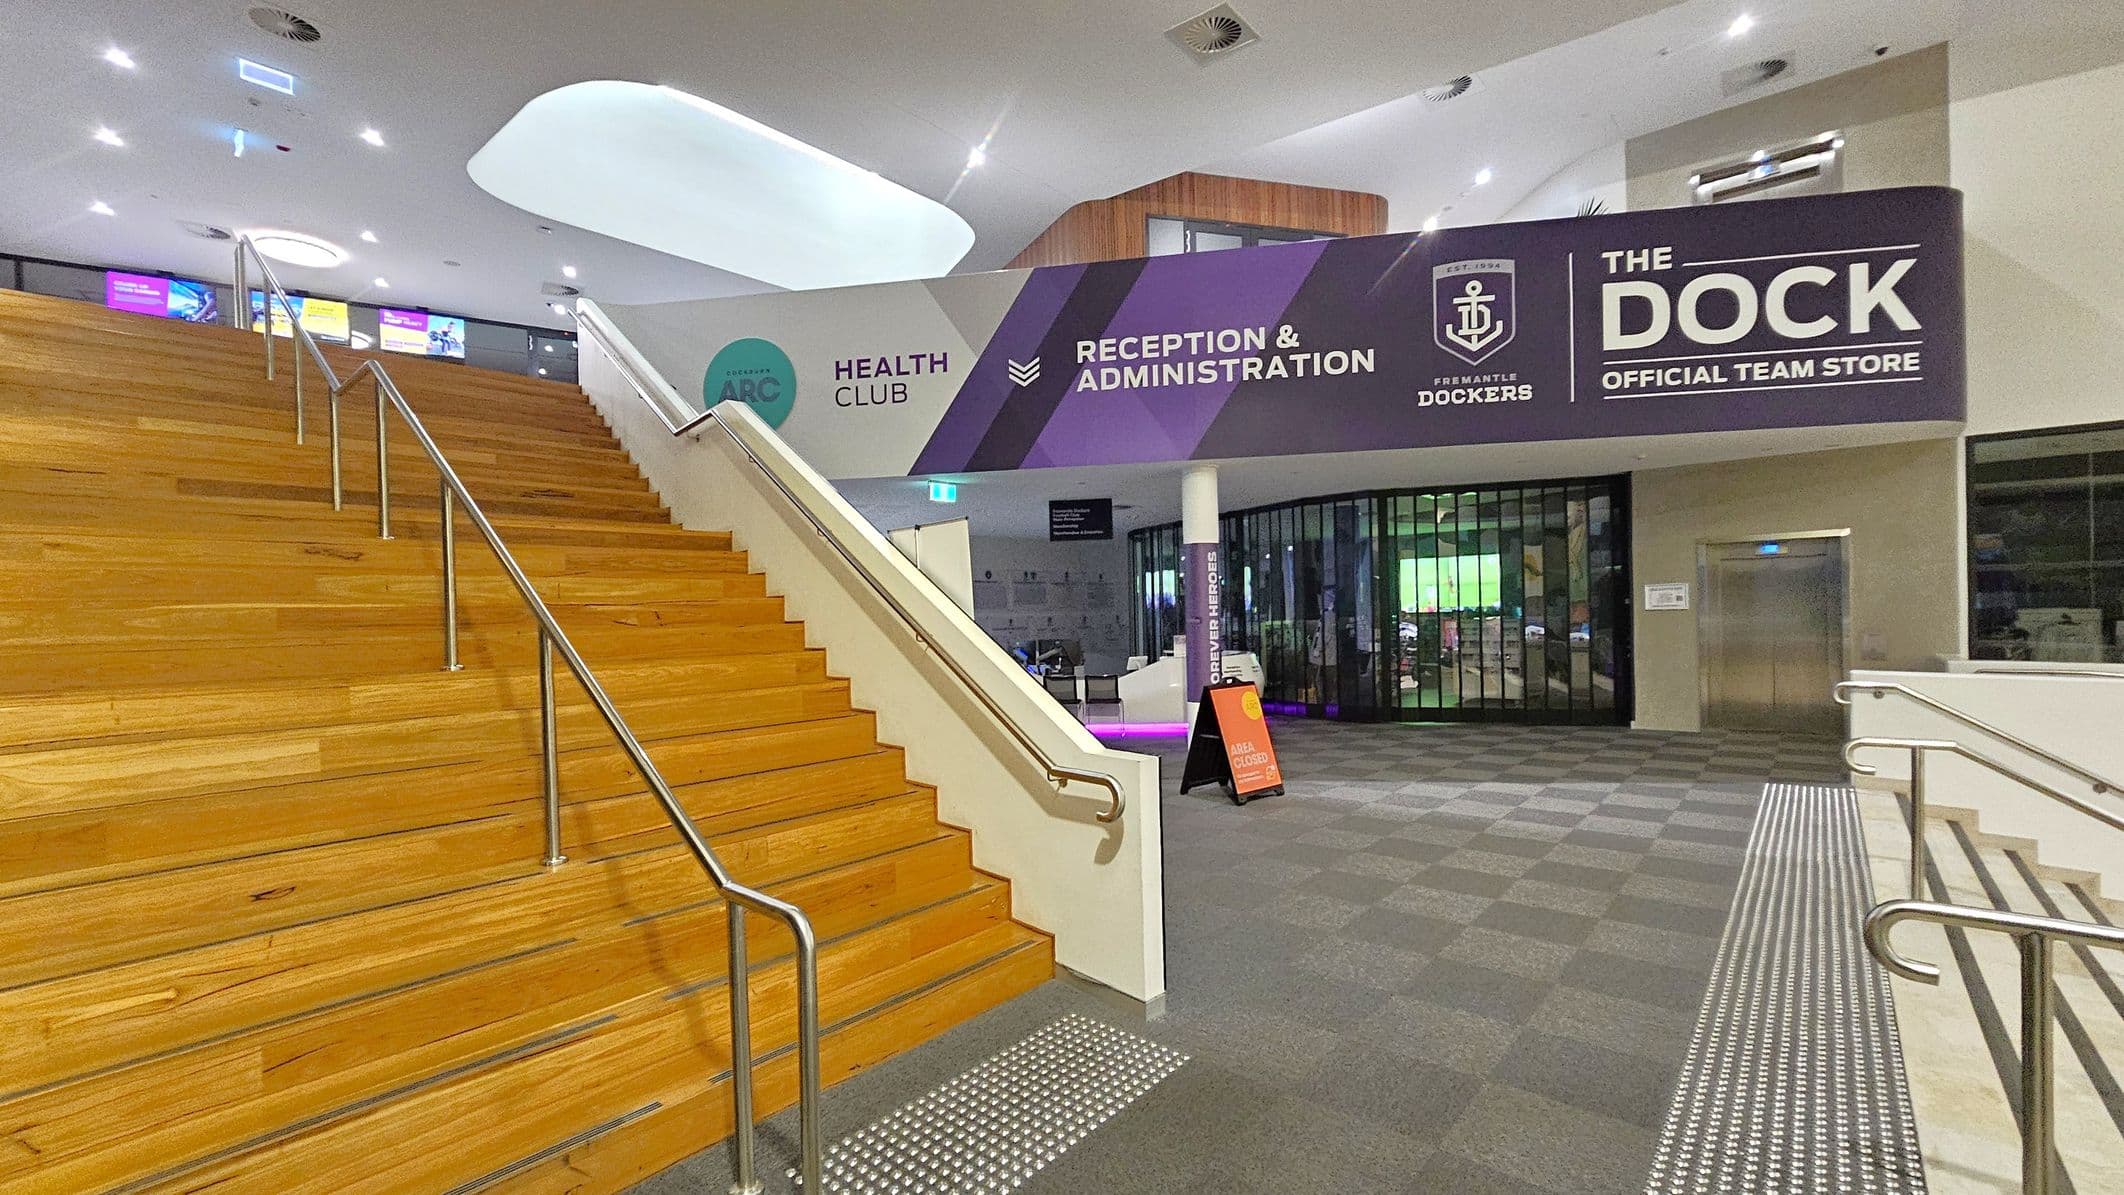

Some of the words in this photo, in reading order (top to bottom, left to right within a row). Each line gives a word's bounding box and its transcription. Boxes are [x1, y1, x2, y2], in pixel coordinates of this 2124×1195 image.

[1476, 262, 1501, 270] 1994
[1602, 246, 1673, 274] THE
[1602, 258, 1922, 351] DOCK
[1076, 326, 1267, 364] RECEPTION
[1276, 324, 1300, 348] &
[834, 352, 949, 381] HEALTH
[1076, 347, 1376, 392] ADMINISTRATION
[1433, 373, 1518, 386] FREMANTLE
[1602, 365, 1728, 390] OFFICIAL
[1734, 359, 1814, 382] TEAM
[1822, 352, 1920, 377] STORE
[718, 376, 781, 403] ARC
[834, 383, 908, 407] CLUB
[1417, 384, 1533, 407] DOCKERS
[1207, 551, 1219, 617] HEROES
[1208, 620, 1221, 685] OREVER
[1230, 741, 1256, 756] AREA
[1234, 752, 1268, 769] CLOSED
